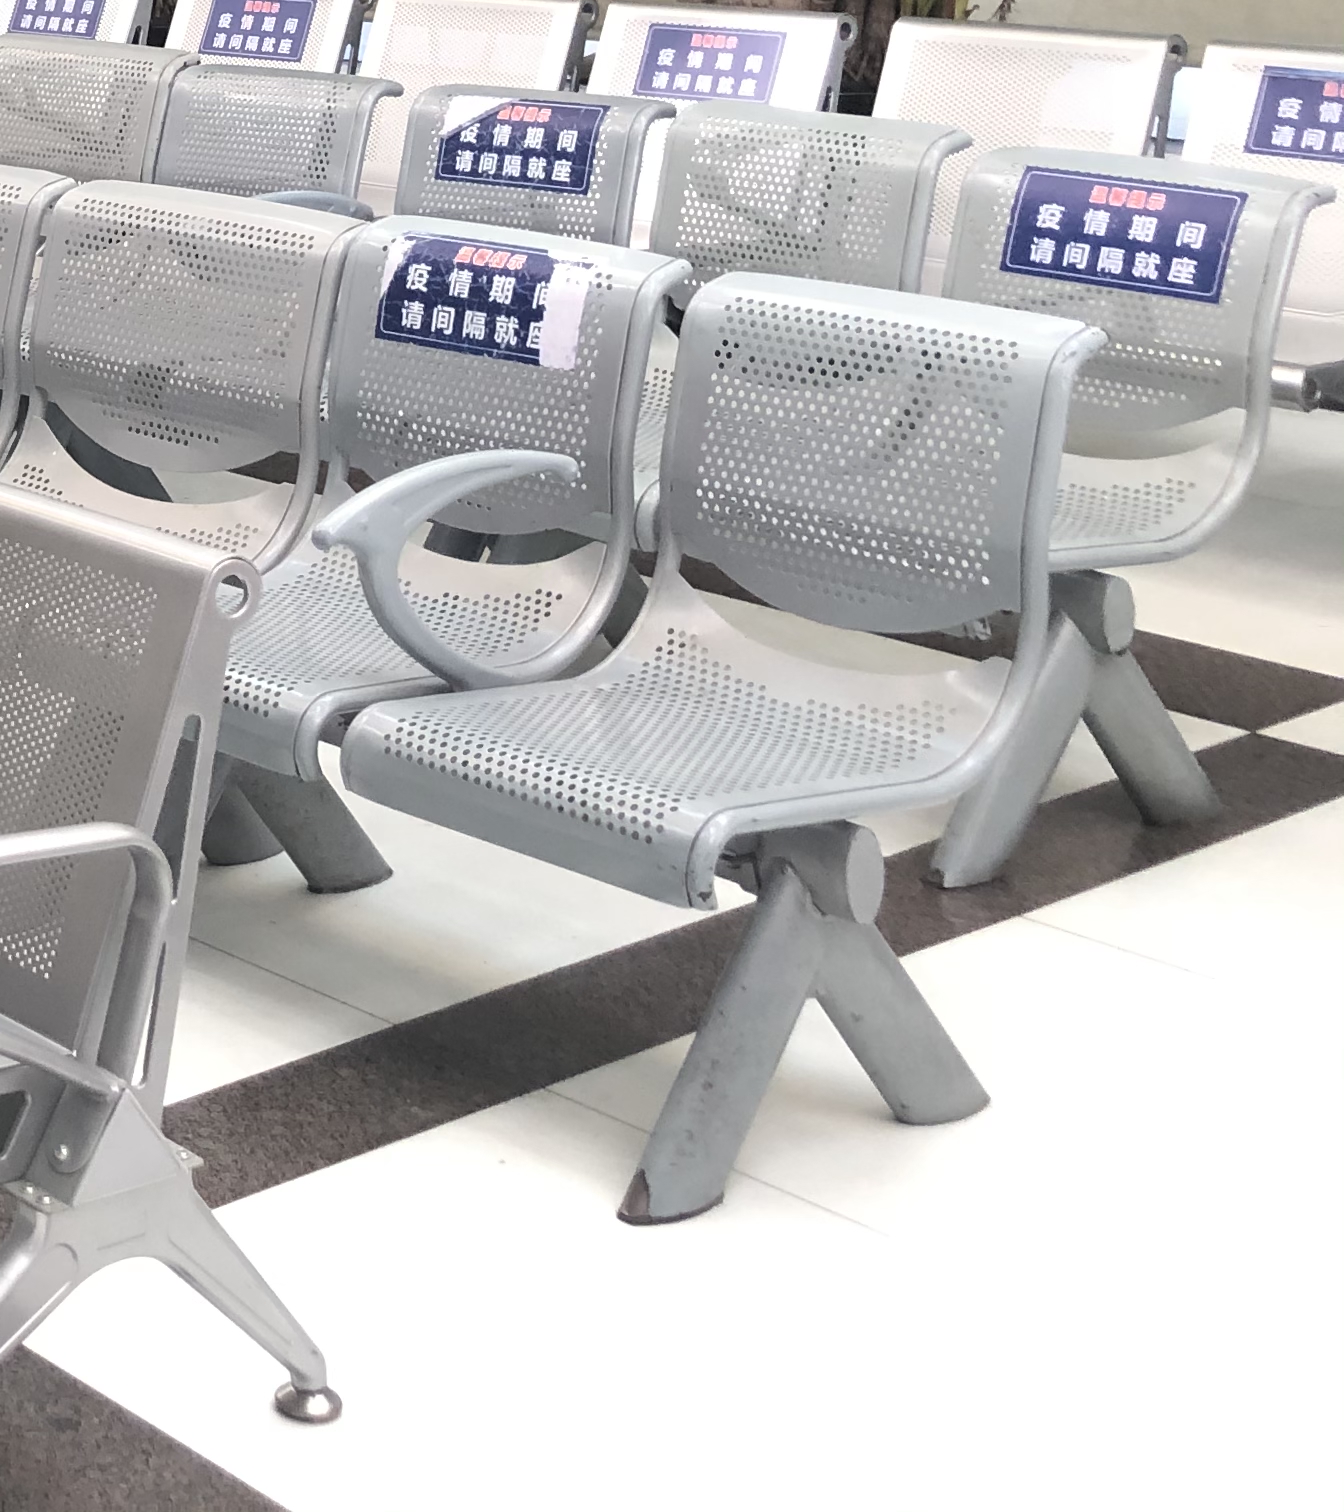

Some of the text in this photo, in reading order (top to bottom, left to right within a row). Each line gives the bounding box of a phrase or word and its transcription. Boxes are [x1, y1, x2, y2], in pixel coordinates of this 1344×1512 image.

[459, 123, 578, 152] 疫情期间
[455, 150, 572, 182] 请间隔就座
[1036, 202, 1207, 249] 疫情期间
[1030, 236, 1198, 284] 请间隔就座
